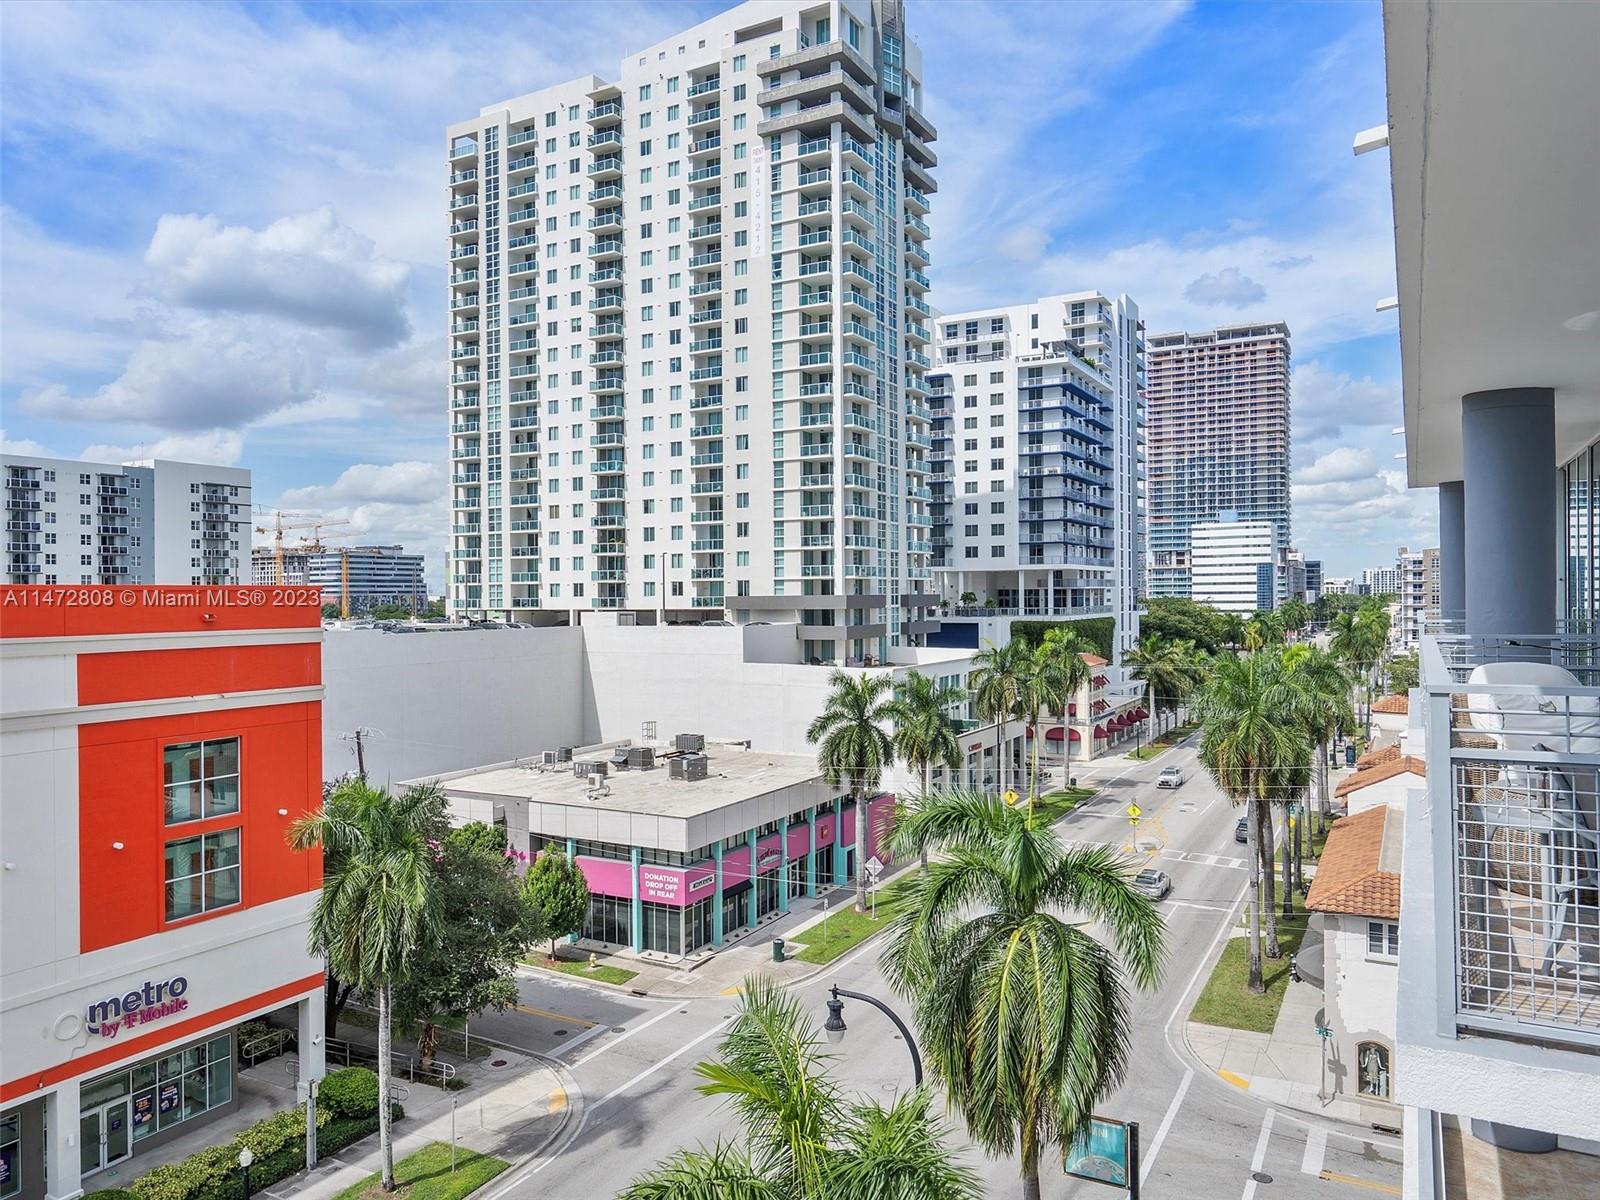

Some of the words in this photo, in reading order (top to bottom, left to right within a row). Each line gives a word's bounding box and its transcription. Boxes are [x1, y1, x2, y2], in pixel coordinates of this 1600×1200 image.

[644, 872, 679, 884] DONATION
[645, 881, 664, 890] DROP
[664, 884, 679, 892] OFF
[656, 890, 675, 899] REAR
[87, 976, 188, 1023] metro
[101, 1021, 120, 1038] by
